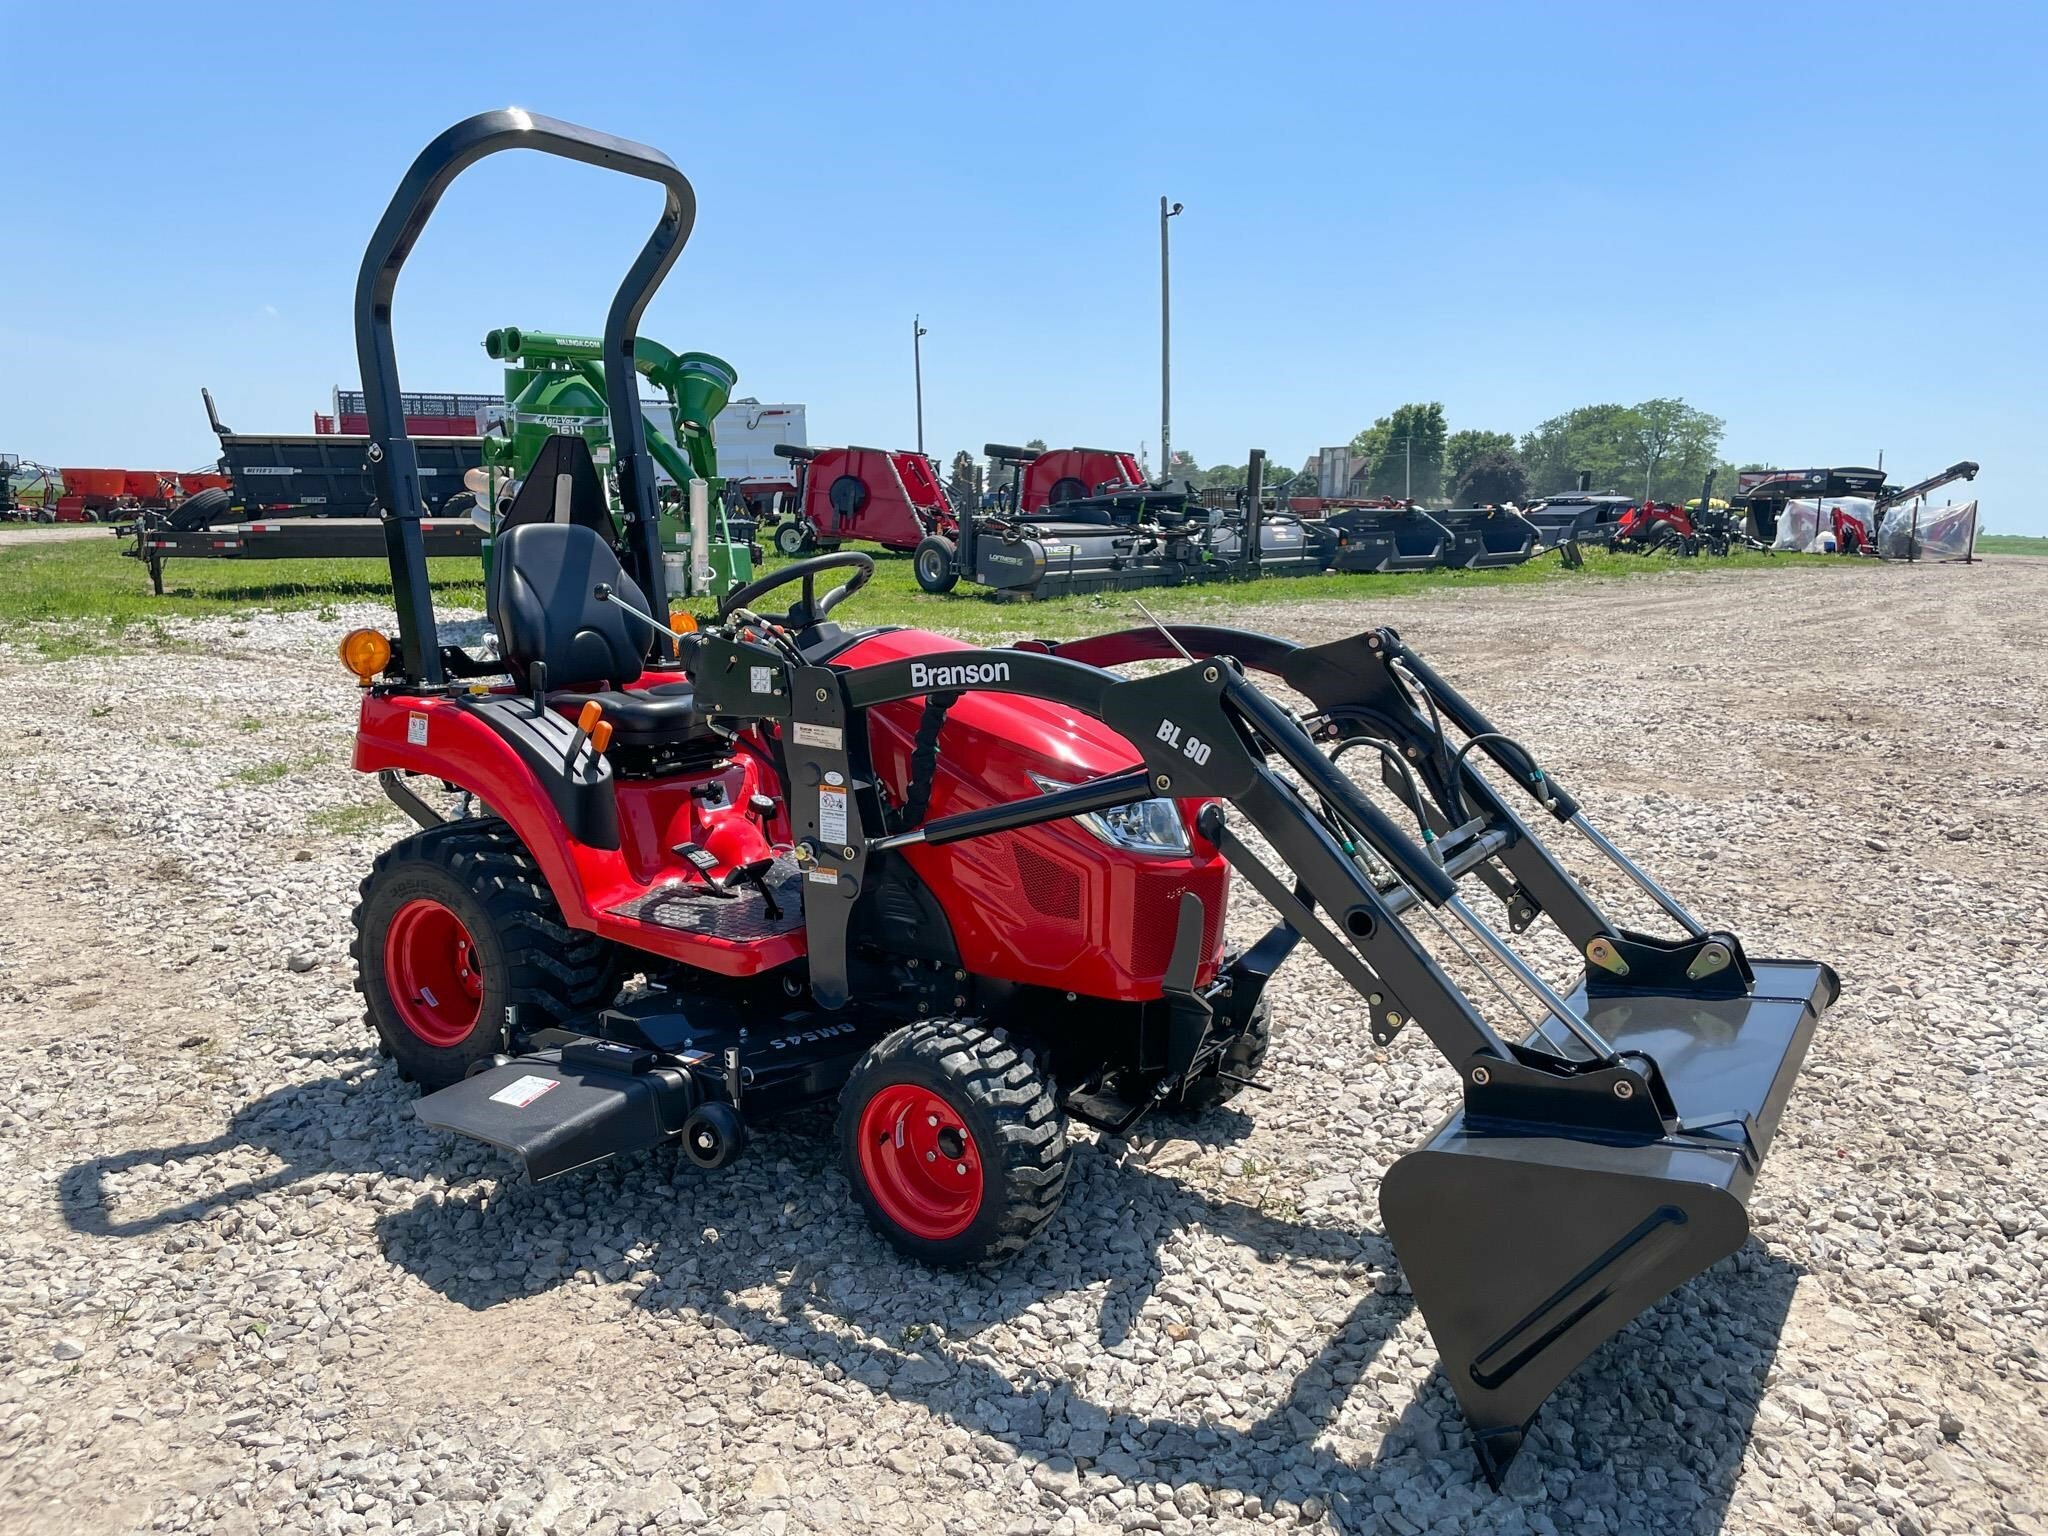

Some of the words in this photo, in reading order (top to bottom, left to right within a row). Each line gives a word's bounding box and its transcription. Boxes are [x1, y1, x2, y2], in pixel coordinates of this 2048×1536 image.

[541, 415, 575, 428] Agri-Vac
[551, 425, 584, 435] 7614
[910, 662, 1010, 688] Branson
[1156, 718, 1181, 750] BL
[1183, 736, 1211, 766] 90
